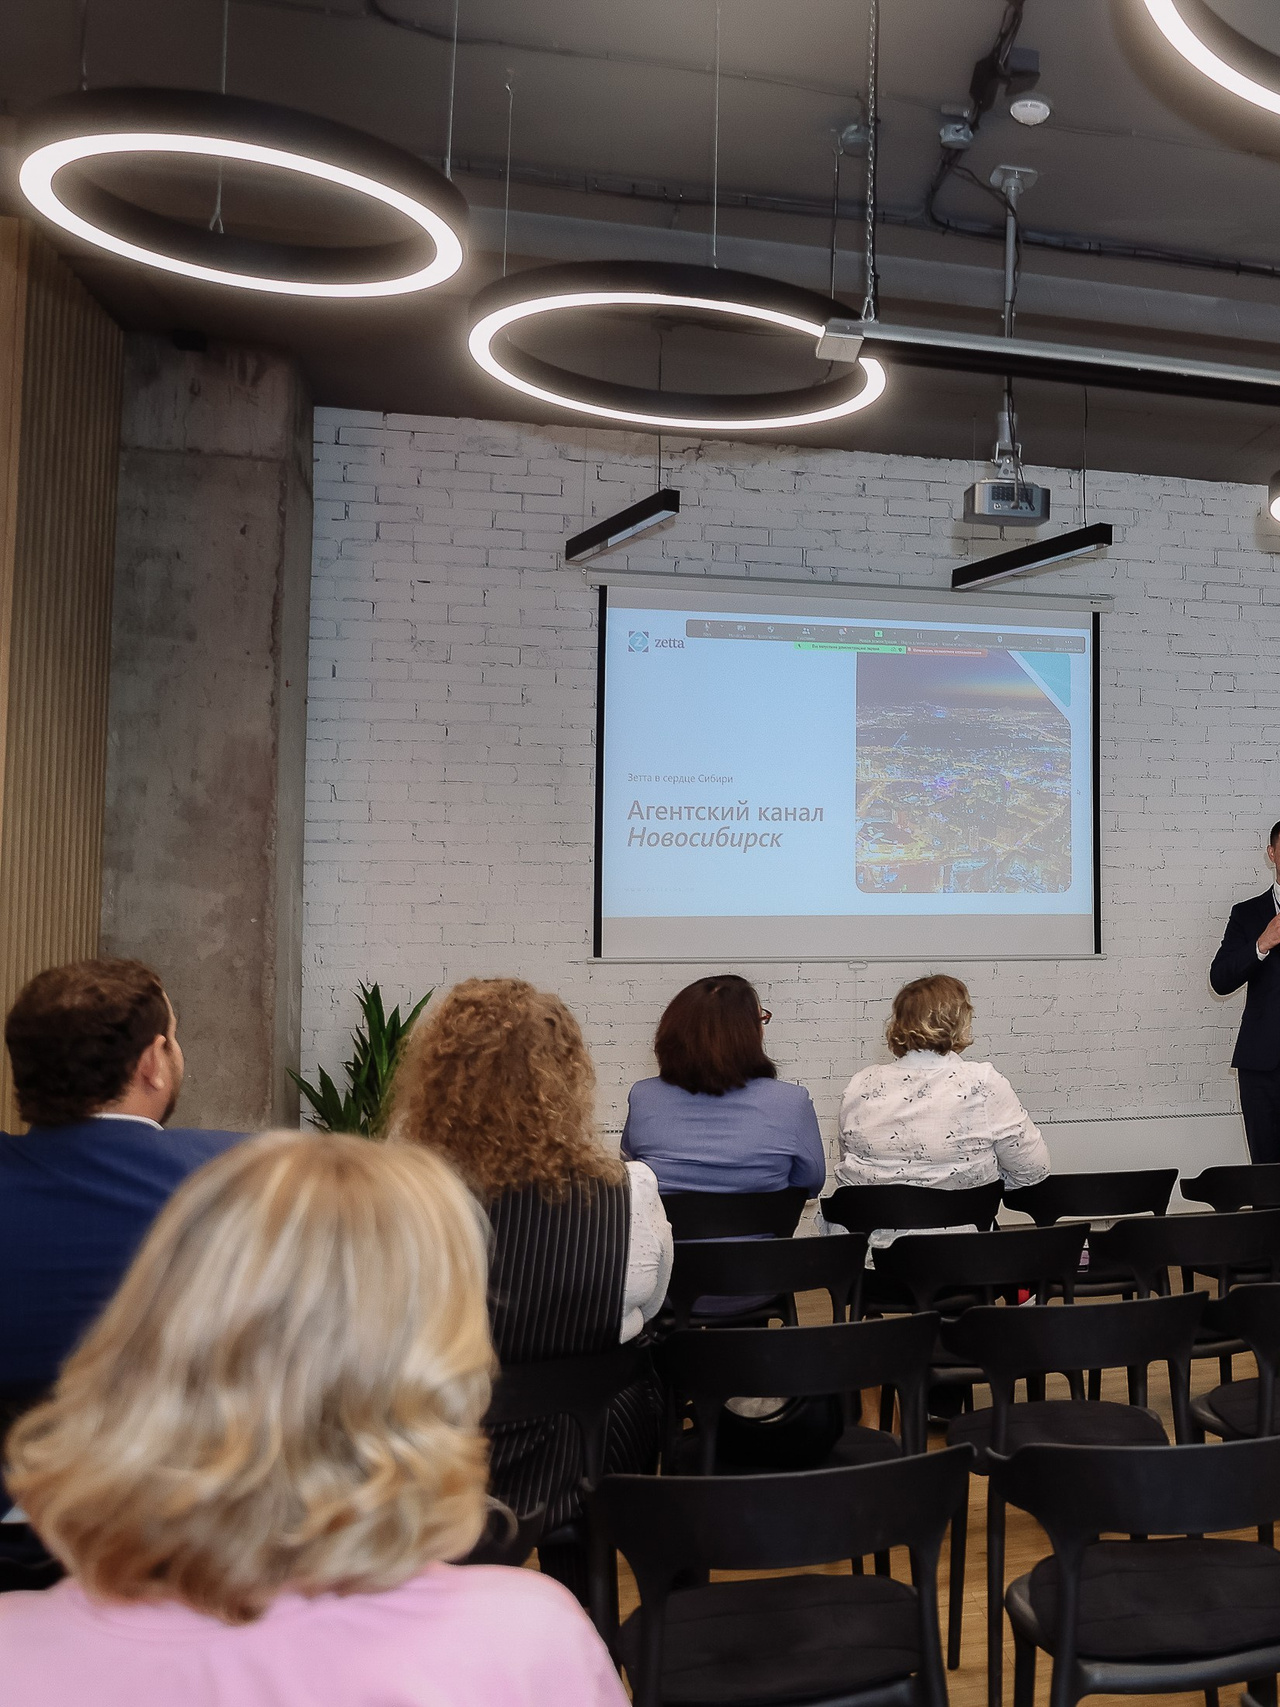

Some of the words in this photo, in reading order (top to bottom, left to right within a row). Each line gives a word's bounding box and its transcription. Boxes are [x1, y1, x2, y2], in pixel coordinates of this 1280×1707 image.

[654, 638, 685, 649] zetta
[627, 773, 652, 783] Зетта
[655, 775, 660, 783] в
[663, 775, 695, 785] сердце
[698, 774, 733, 785] Сибири
[627, 800, 750, 821] Агентский
[758, 806, 824, 822] канал
[627, 826, 783, 853] Новосибирск
